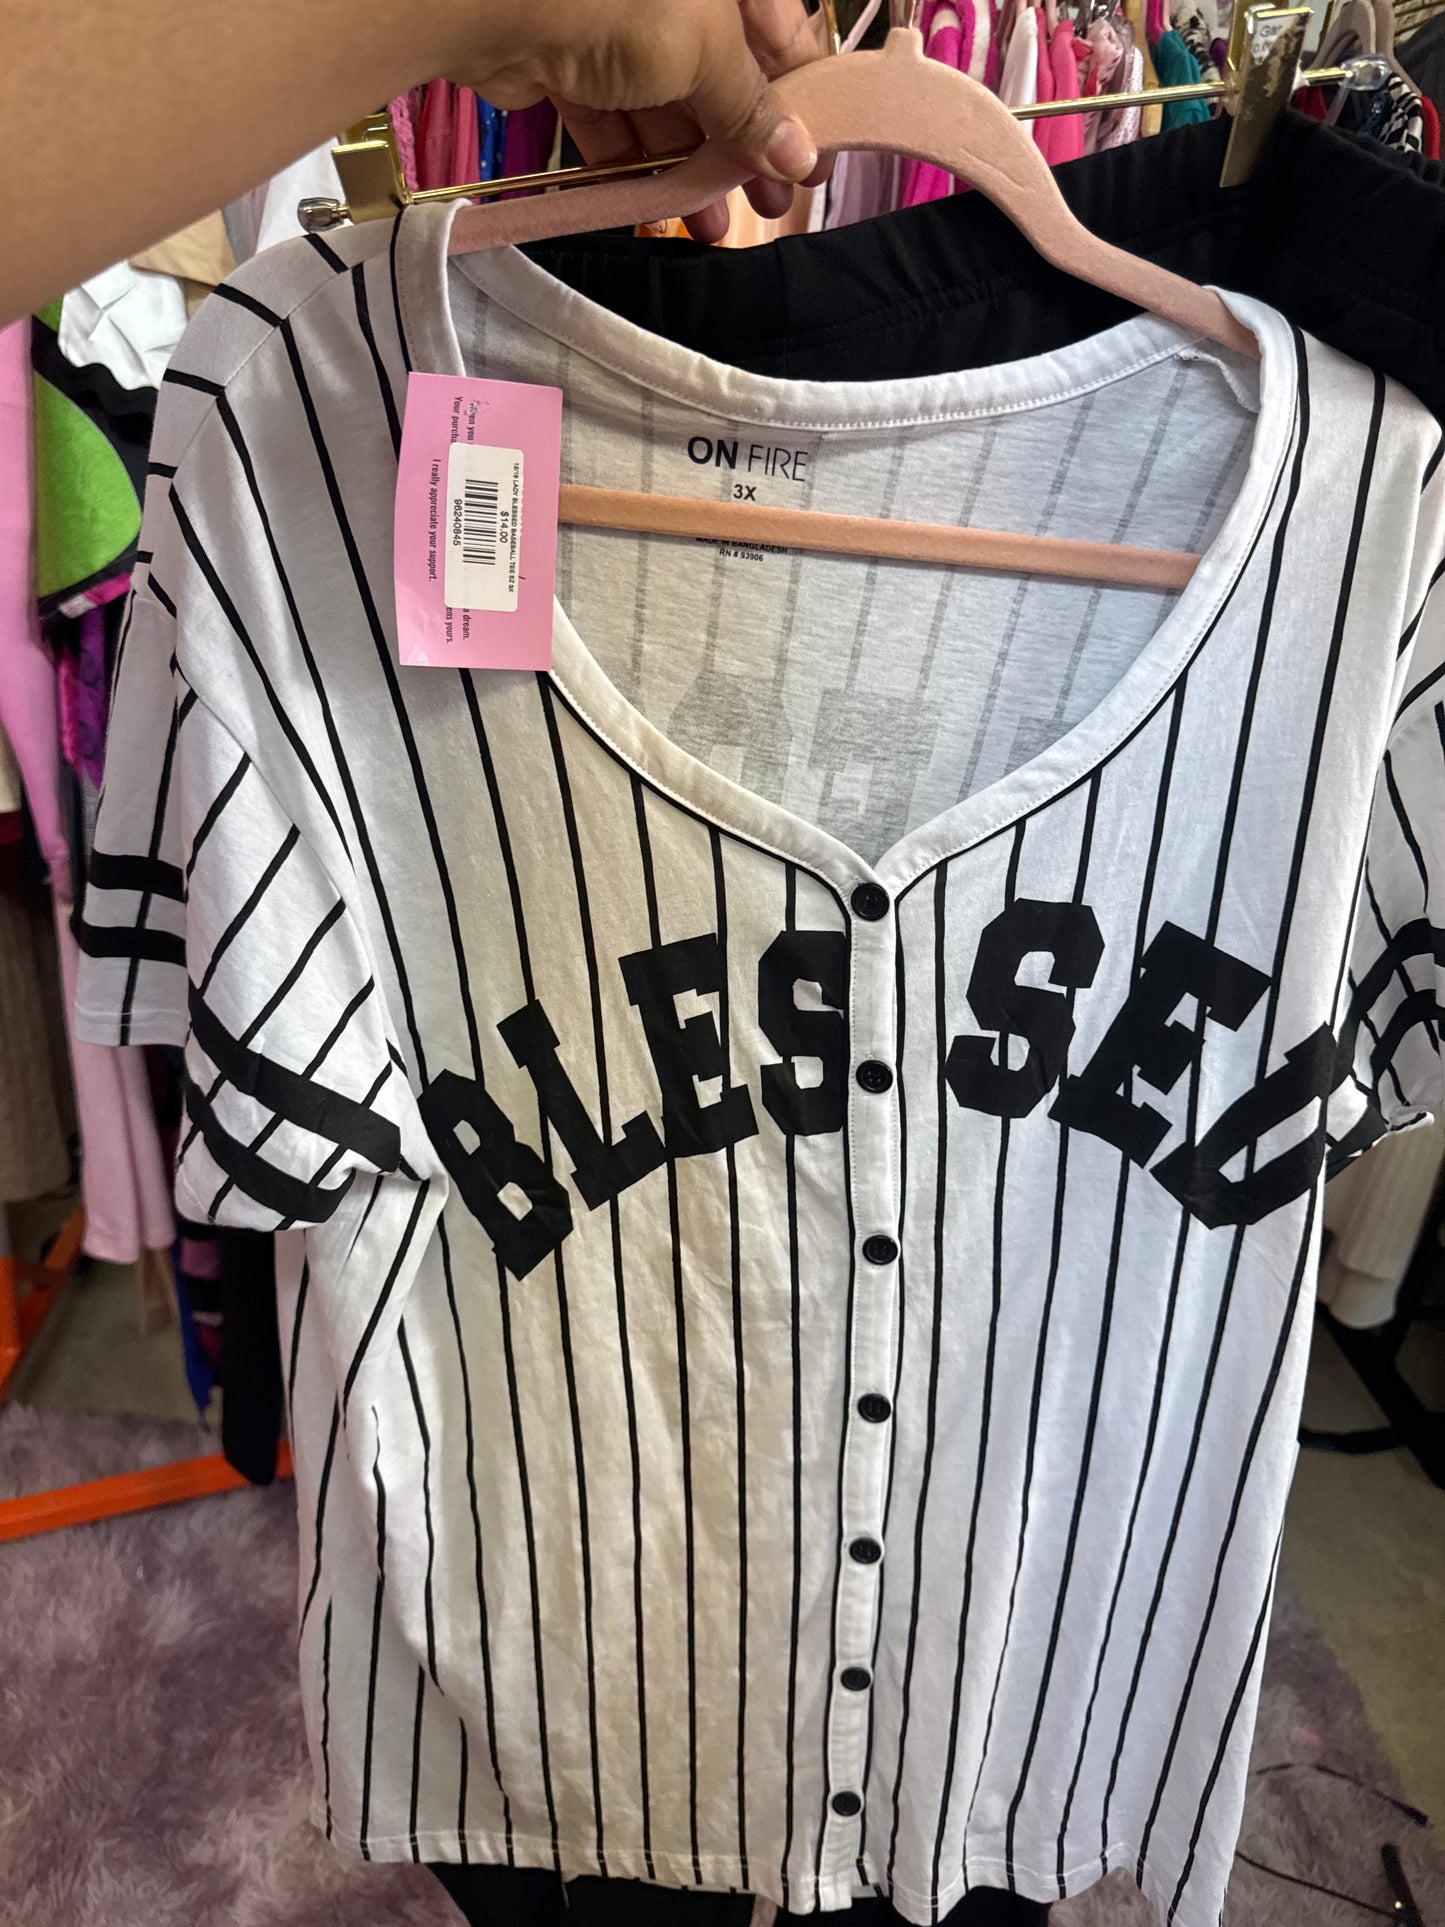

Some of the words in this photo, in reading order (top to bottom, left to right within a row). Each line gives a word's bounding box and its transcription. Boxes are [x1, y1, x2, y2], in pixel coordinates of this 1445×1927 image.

[453, 396, 463, 414] Your
[467, 426, 475, 441] you
[687, 436, 739, 470] ON
[747, 444, 808, 481] FIRE
[429, 463, 440, 487] really
[733, 483, 757, 501] 3X
[428, 488, 438, 529] appreciate
[453, 499, 463, 546] 96240845
[500, 511, 509, 544] $14.00
[428, 530, 437, 548] your
[731, 541, 788, 555] BANGLADESH
[427, 550, 438, 582] support.
[719, 548, 732, 558] RN
[740, 551, 764, 562] 93906
[445, 621, 453, 644] yours.
[463, 614, 472, 640] dream.
